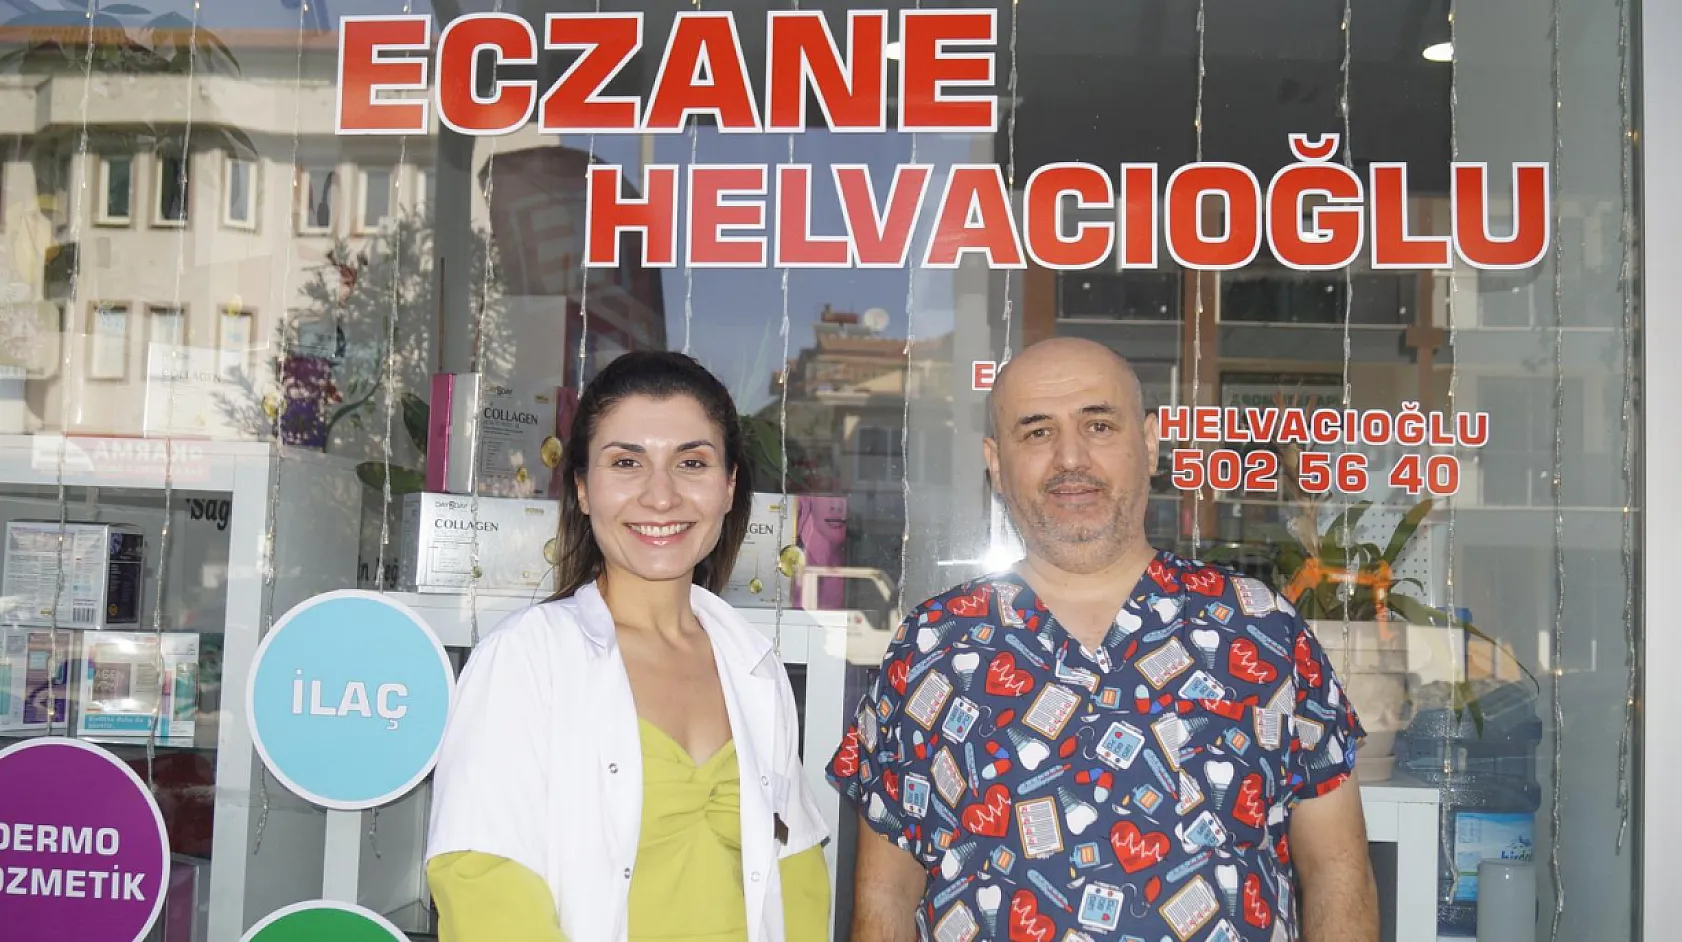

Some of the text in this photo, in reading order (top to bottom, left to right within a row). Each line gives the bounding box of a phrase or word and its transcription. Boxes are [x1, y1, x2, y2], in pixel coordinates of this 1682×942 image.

[335, 8, 998, 135] ECZANE
[585, 132, 1551, 270] HELVACIOĞLU
[484, 407, 538, 425] COLLAGEN
[1158, 401, 1490, 447] HELVACIOĞLU
[1171, 448, 1461, 495] 502 56 40
[434, 518, 499, 532] COLLAGEN
[291, 669, 408, 730] İLAÇ
